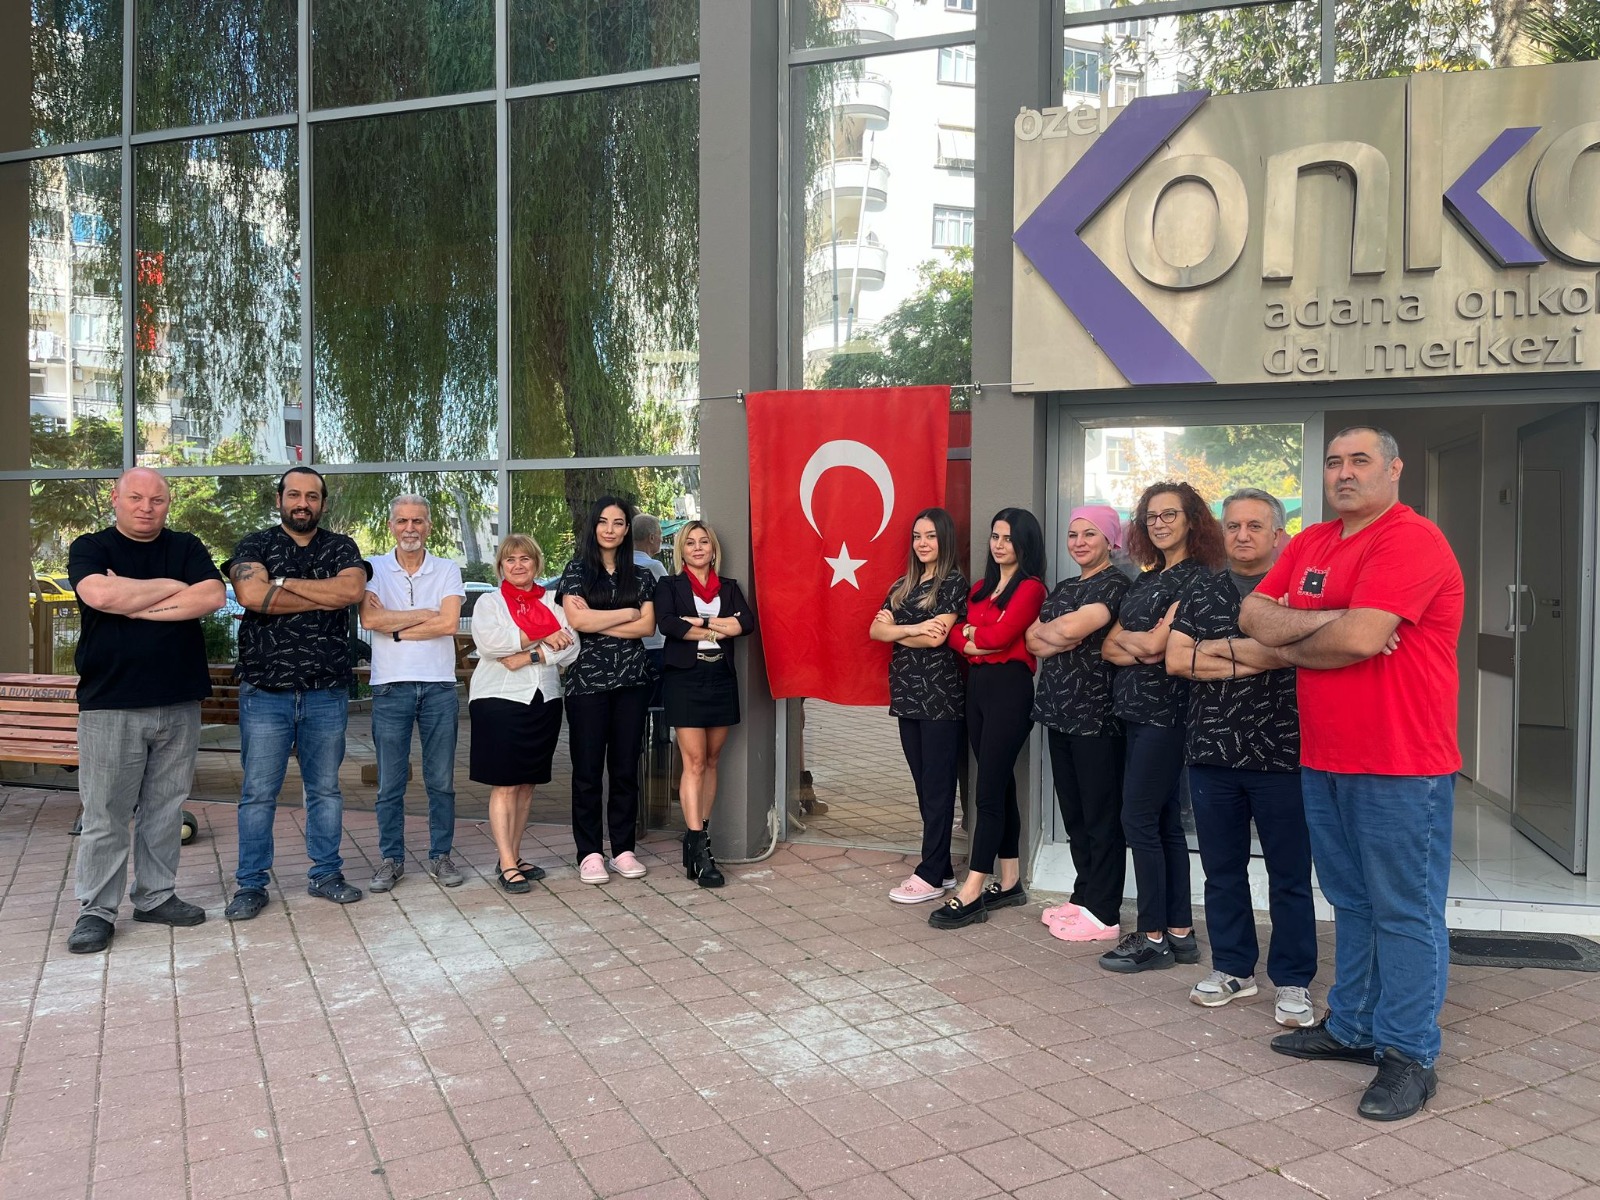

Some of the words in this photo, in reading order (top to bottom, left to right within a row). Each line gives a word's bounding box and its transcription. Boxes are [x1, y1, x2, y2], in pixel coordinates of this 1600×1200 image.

[1264, 286, 1427, 328] adana
[1457, 272, 1600, 319] onko
[1263, 332, 1340, 375] dal
[1365, 324, 1585, 371] merkezi
